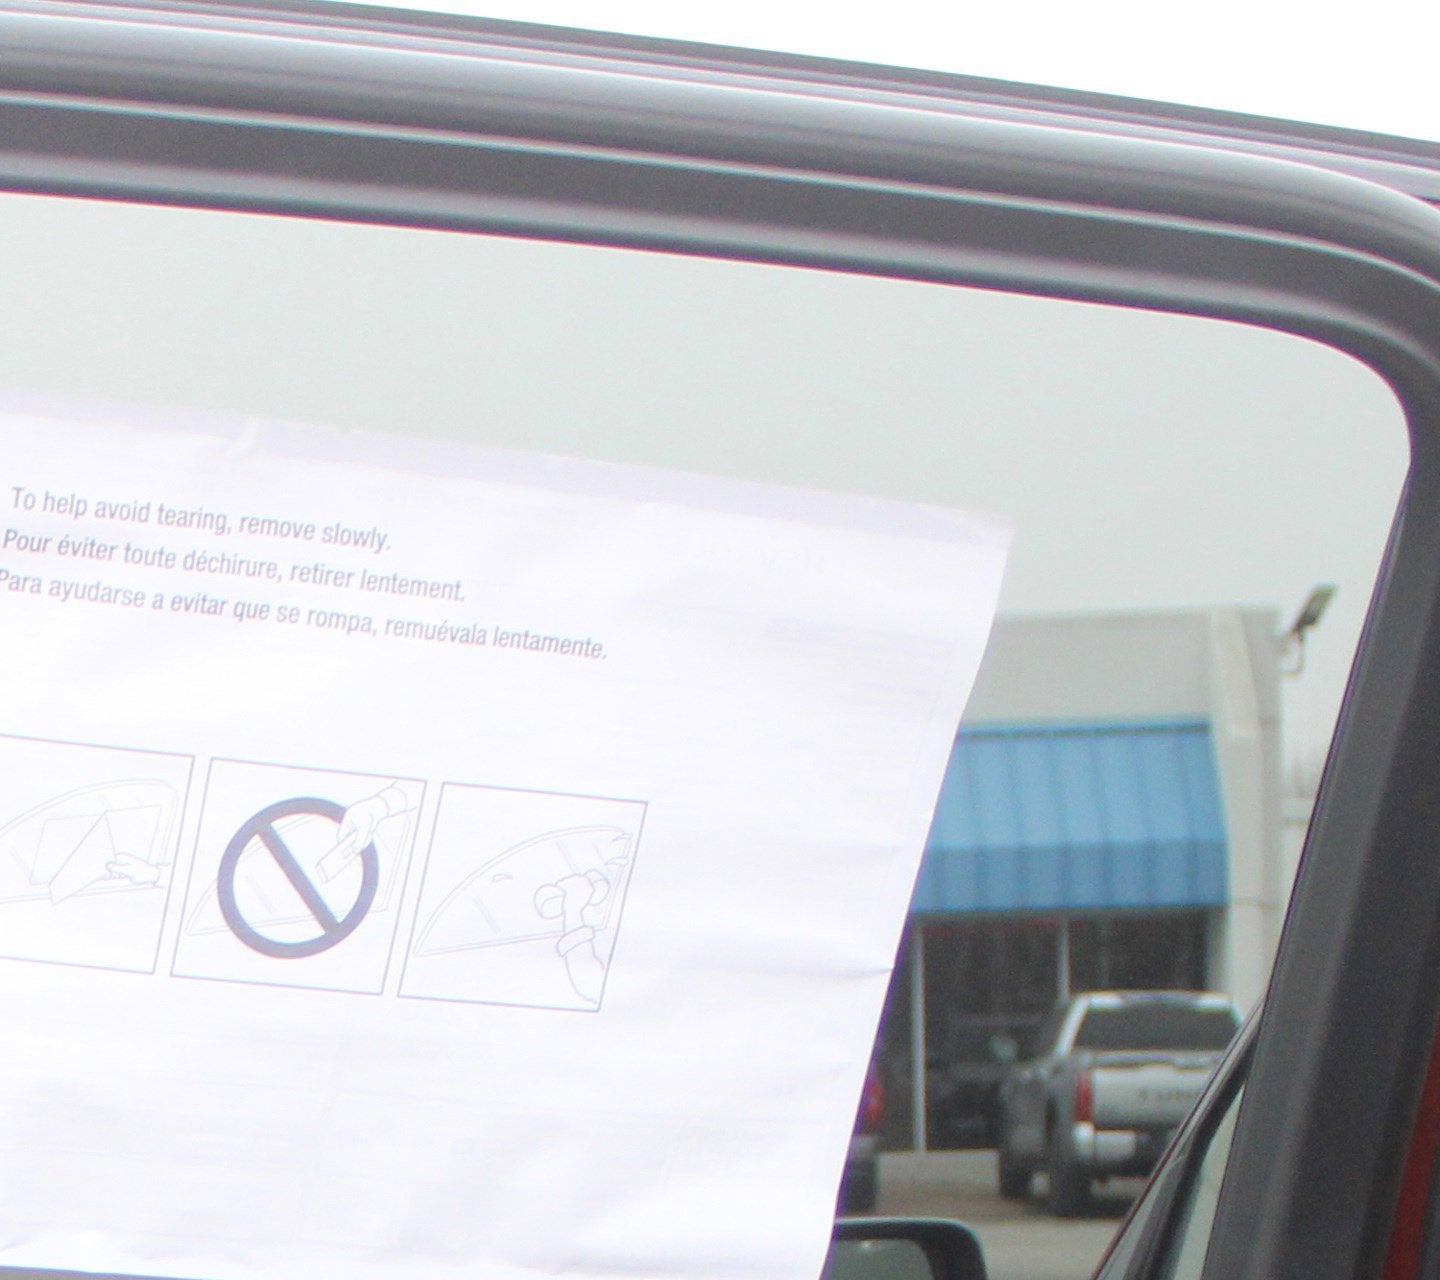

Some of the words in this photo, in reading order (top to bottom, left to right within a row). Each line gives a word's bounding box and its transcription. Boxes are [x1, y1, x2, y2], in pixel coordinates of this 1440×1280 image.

[11, 485, 36, 511] To
[42, 491, 87, 520] help
[95, 498, 150, 523] avoid
[158, 503, 231, 535] tearing,
[239, 515, 315, 541] remove
[322, 521, 391, 554] slowly.
[3, 527, 52, 553] Pour
[57, 533, 118, 560] éviter
[124, 543, 176, 570] toute
[183, 549, 282, 583] déchirure,
[290, 562, 354, 588] retirer
[360, 568, 465, 602] lentement.
[48, 577, 145, 609] ayudarse
[151, 592, 164, 610] a
[170, 593, 228, 617] evitar
[233, 600, 270, 625] que
[276, 604, 301, 625] se
[307, 608, 377, 637] rompa,
[385, 615, 487, 646] remuévala
[492, 626, 607, 660] lentamente.
